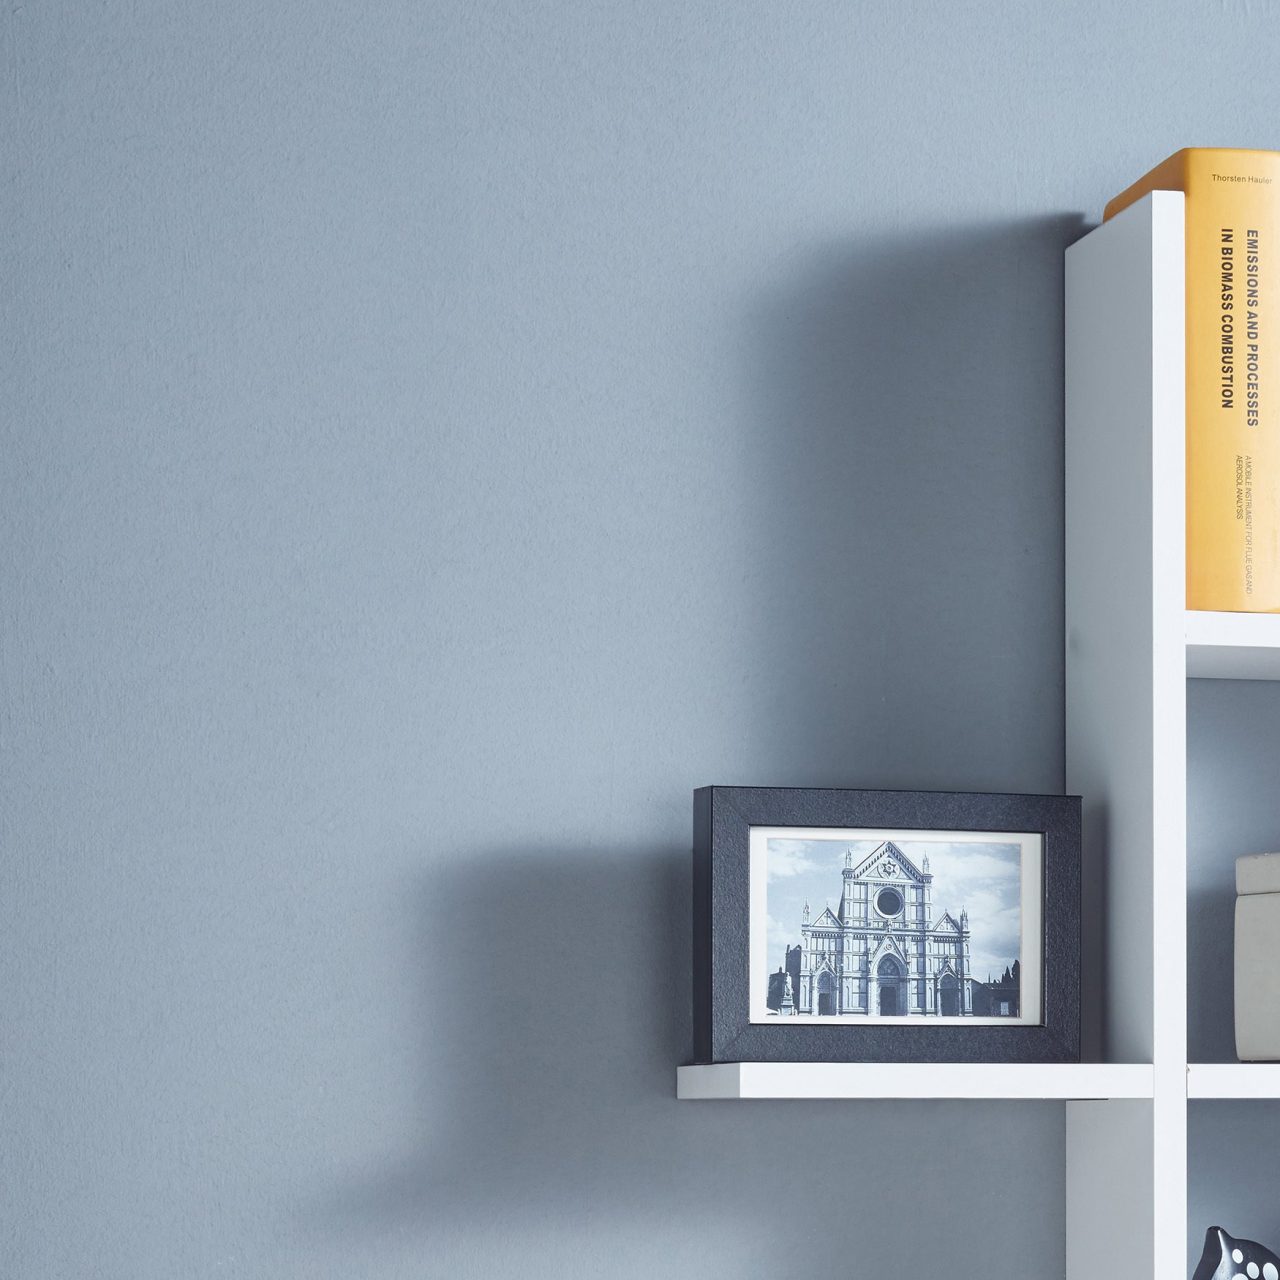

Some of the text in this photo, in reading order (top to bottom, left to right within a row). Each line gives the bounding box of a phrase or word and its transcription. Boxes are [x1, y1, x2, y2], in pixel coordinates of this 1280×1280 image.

[1212, 173, 1247, 183] Thorsten
[1221, 228, 1234, 409] IN BIOMASS COMBUSTION
[1246, 229, 1258, 427] EMISSIONS AND PROCESSES
[1236, 487, 1244, 520] ANALYSIS
